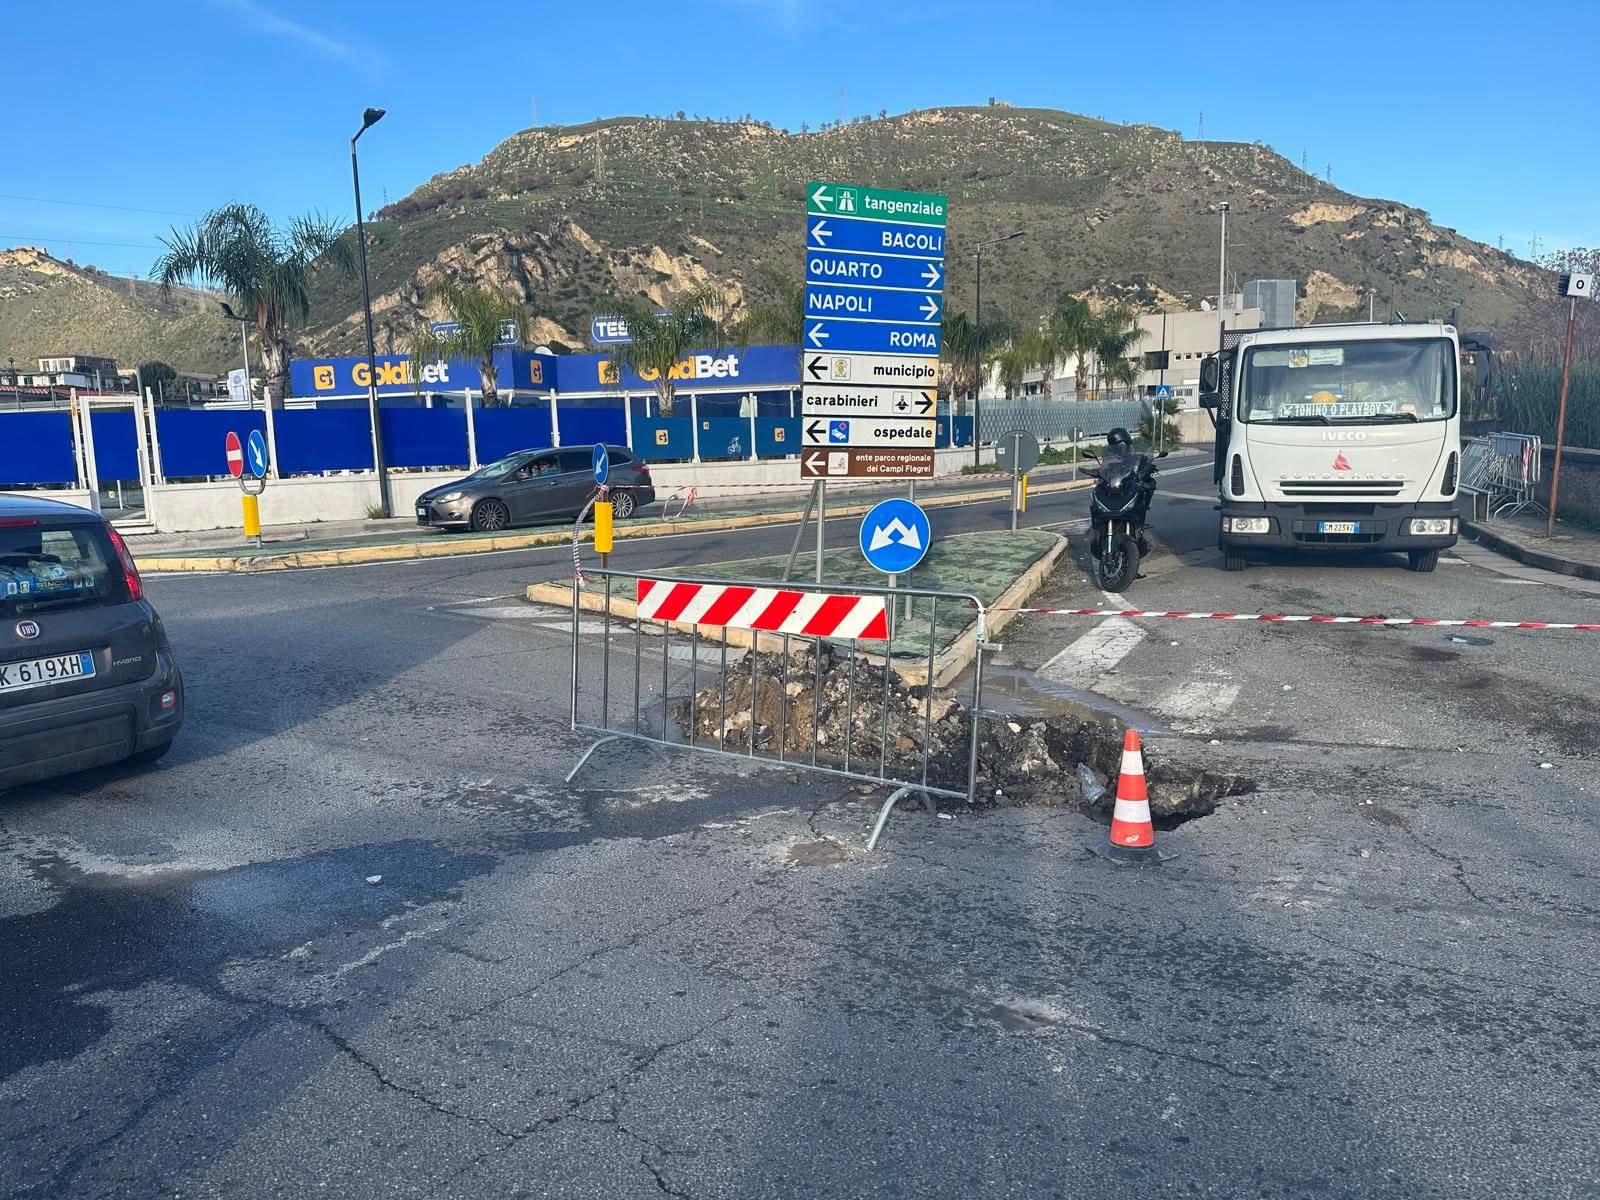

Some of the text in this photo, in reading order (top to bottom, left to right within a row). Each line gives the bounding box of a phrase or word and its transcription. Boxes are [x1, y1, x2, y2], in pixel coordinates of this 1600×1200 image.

[865, 195, 943, 215] tangenziale
[882, 231, 942, 251] BACOLI
[810, 259, 882, 279] QUARTO
[809, 293, 872, 312] NAPOLI
[889, 331, 937, 347] ROMA
[873, 364, 935, 379] municipio
[806, 394, 878, 407] carabinieri
[1339, 402, 1381, 416] PLAYBOY
[873, 427, 933, 440] ospedale
[1322, 431, 1367, 441] IVECO
[855, 454, 932, 463] ente parco regionale
[866, 465, 931, 474] dei Campi Flegrei
[19, 655, 82, 683] 619XH
